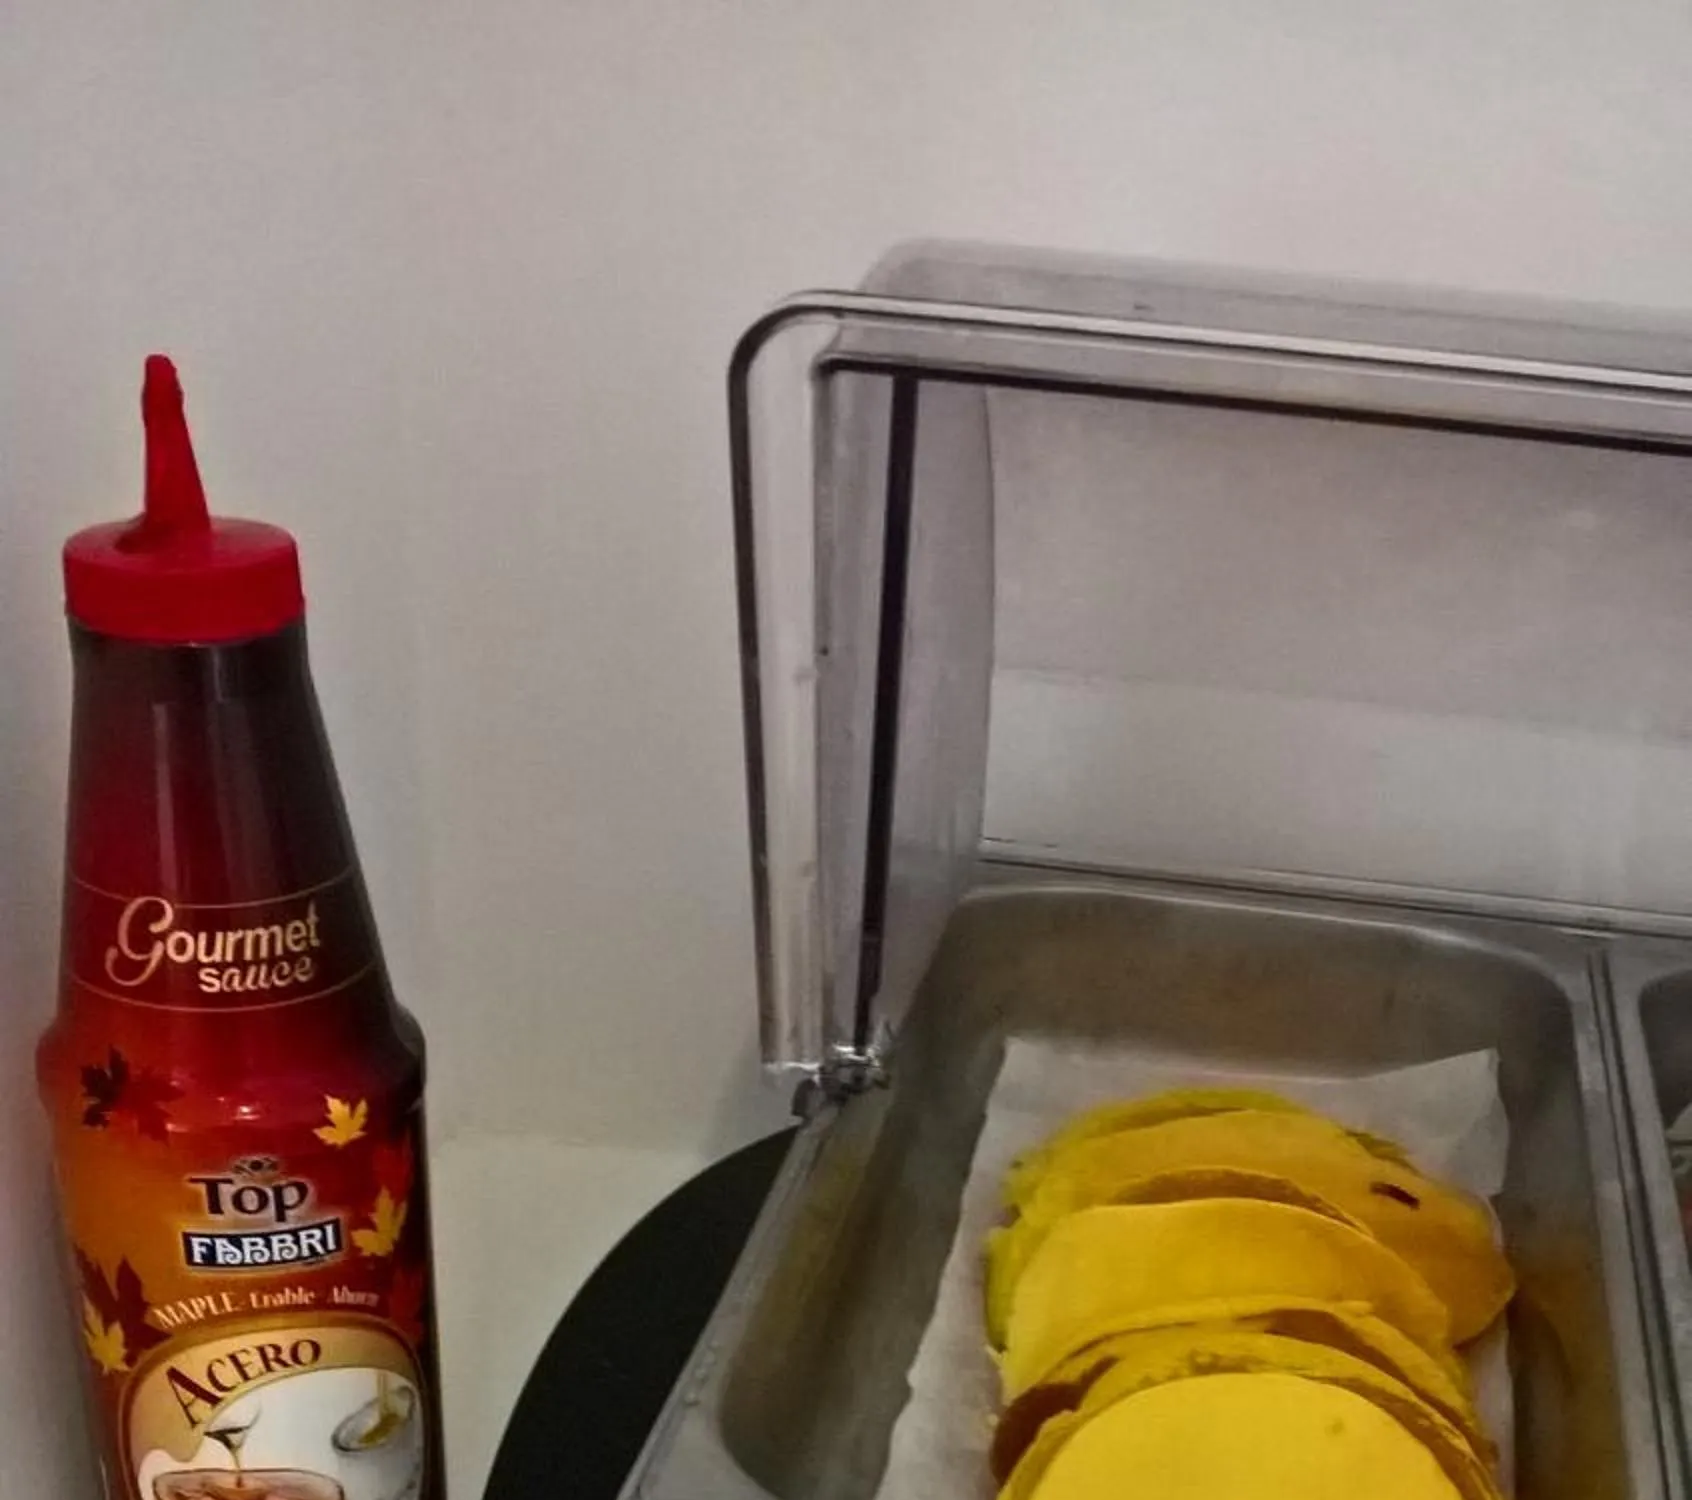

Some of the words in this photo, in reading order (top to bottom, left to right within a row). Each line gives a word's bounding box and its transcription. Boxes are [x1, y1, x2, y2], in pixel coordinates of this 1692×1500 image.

[105, 896, 322, 987] Gourmet
[199, 955, 315, 993] sauce
[188, 1174, 310, 1222] Top
[190, 1224, 337, 1266] FABBRI
[153, 1291, 238, 1330] MAPLE
